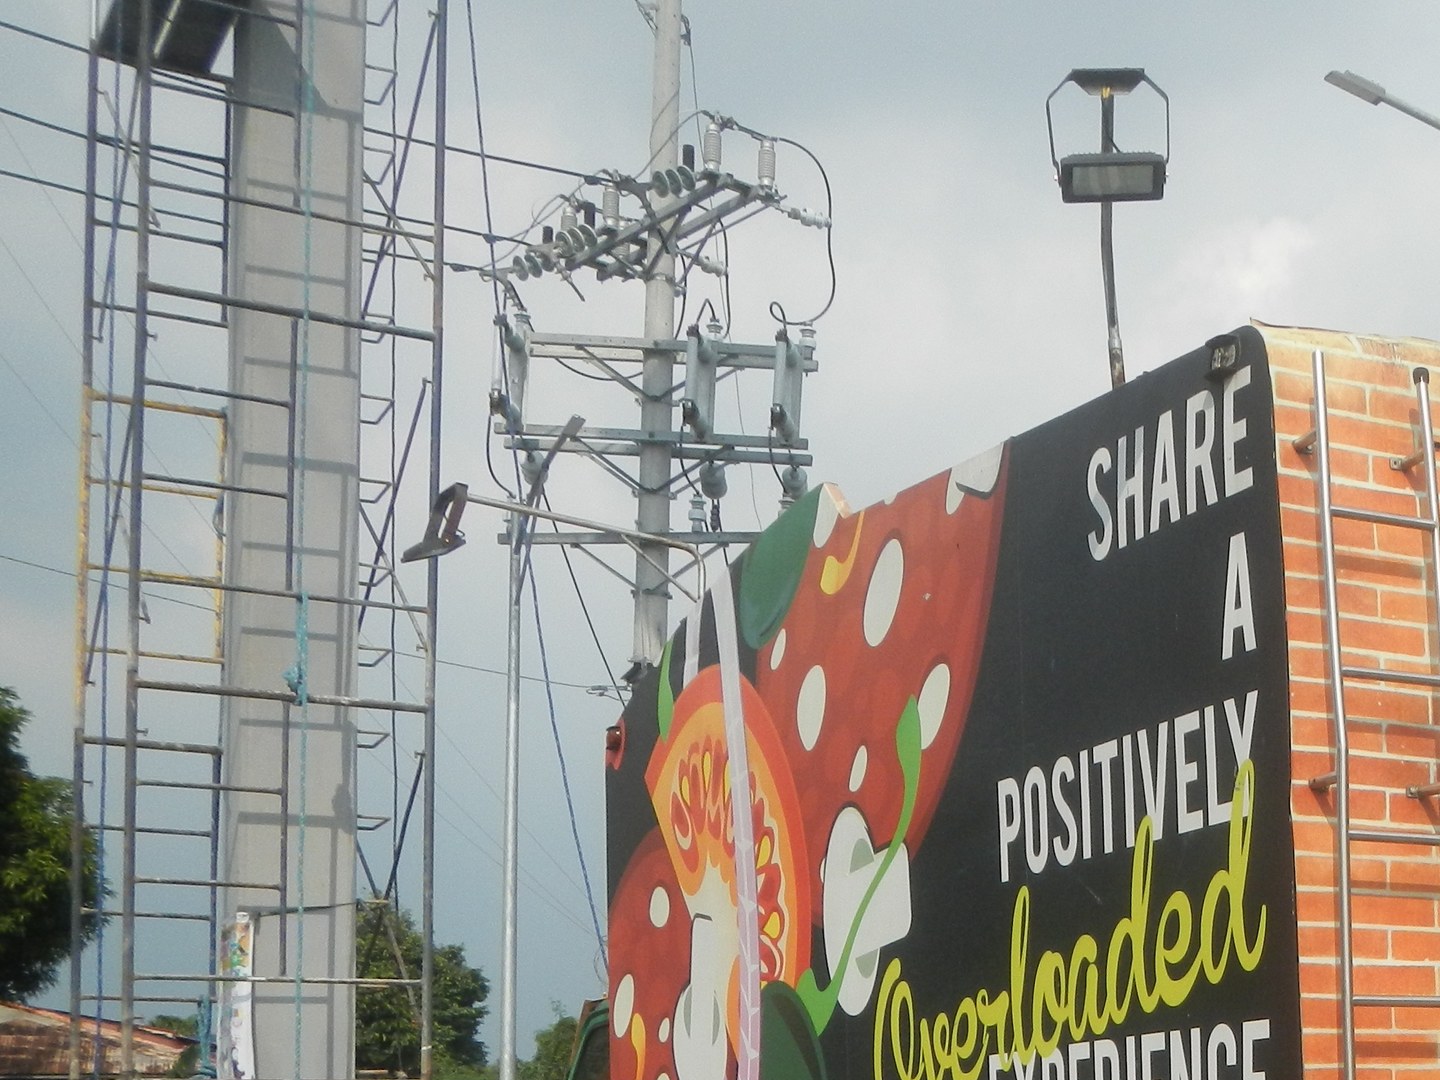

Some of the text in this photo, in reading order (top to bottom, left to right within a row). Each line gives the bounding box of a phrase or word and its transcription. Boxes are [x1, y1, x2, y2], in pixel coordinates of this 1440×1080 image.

[1087, 365, 1254, 561] SHARE
[1221, 531, 1257, 661] A
[997, 690, 1258, 883] POSITIVELY
